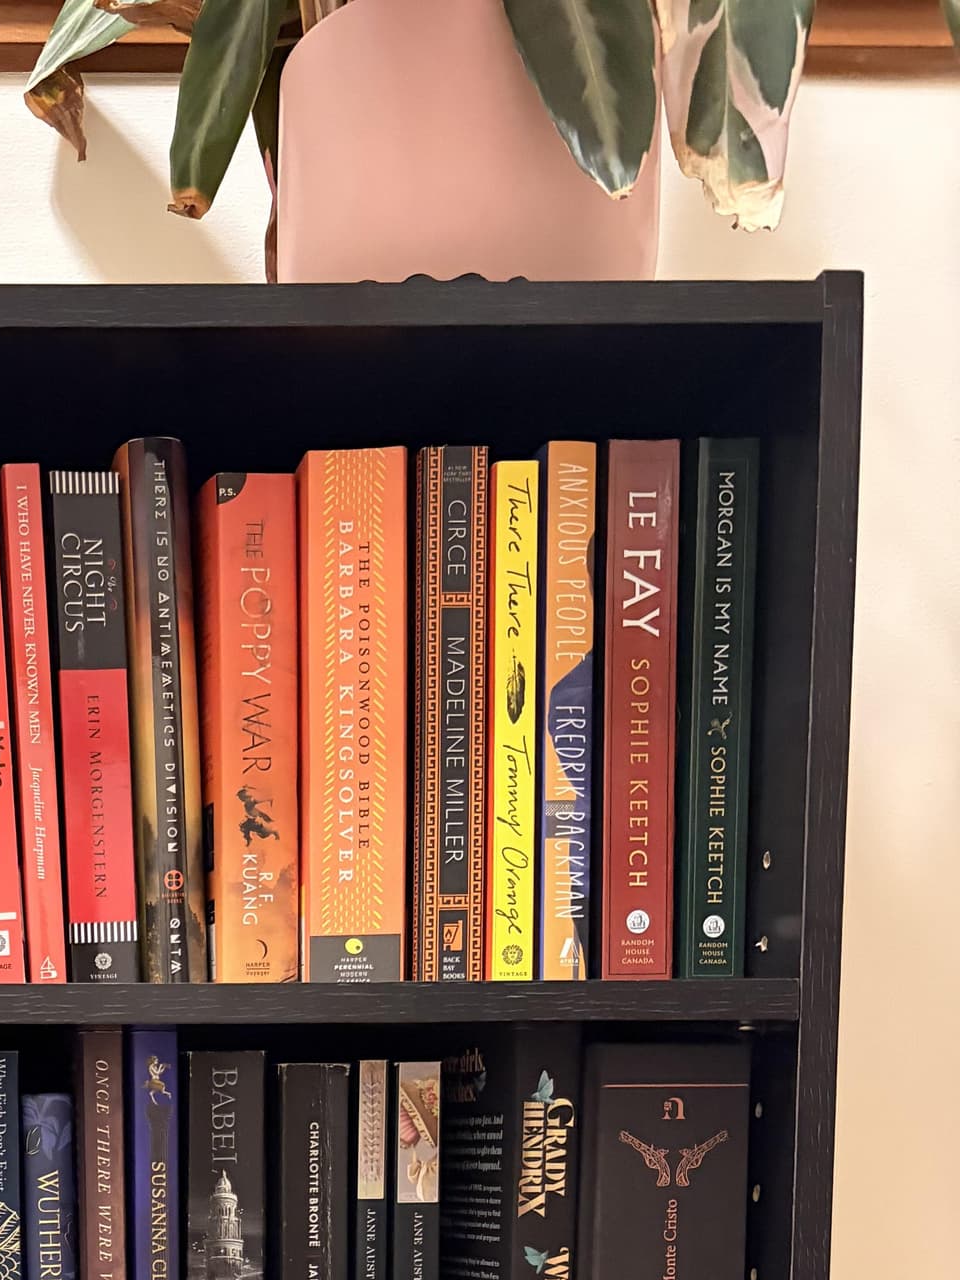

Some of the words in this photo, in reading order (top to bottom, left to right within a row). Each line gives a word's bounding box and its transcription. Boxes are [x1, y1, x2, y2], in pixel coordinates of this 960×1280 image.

[245, 520, 264, 558] THE
[447, 500, 466, 575] CIRCE
[507, 477, 532, 553] There
[558, 463, 588, 566] ANXIOUS
[628, 491, 657, 528] LE
[61, 532, 84, 633] CIRCUS
[83, 539, 106, 627] NIGHT
[241, 567, 271, 684] POPPY
[339, 520, 354, 664] BARBARA
[506, 561, 532, 638] There
[555, 579, 586, 662] PEOPLE
[623, 549, 661, 638] FAY
[241, 693, 272, 774] WAR
[446, 637, 465, 768] MADELINE
[338, 684, 354, 883] KINGSOLVER
[445, 779, 465, 864] MILLER
[211, 1067, 238, 1173] BABEL
[151, 1161, 167, 1253] SUSANNA
[366, 1208, 376, 1242] JANE
[663, 1199, 678, 1241] Cristo
